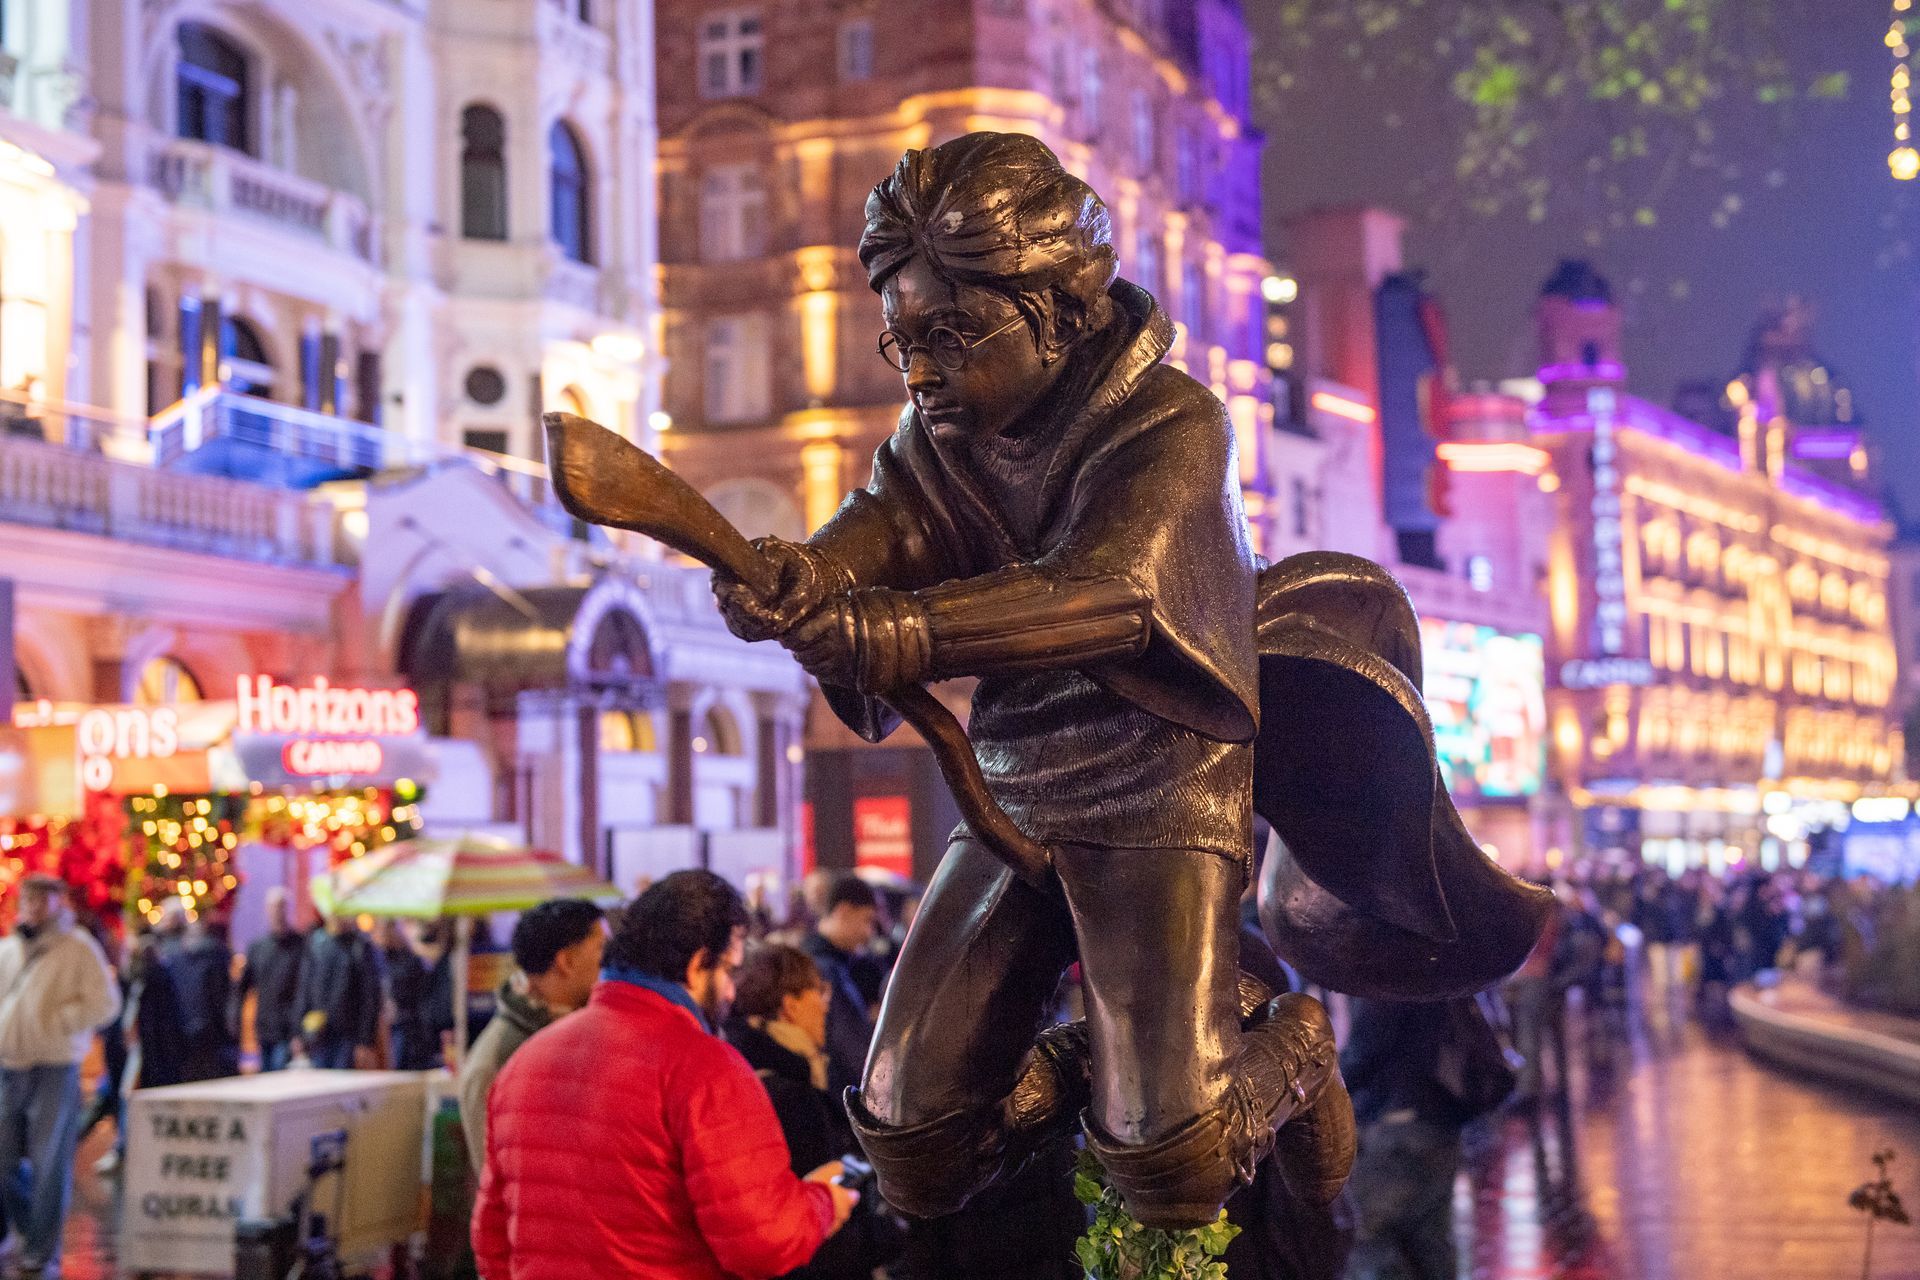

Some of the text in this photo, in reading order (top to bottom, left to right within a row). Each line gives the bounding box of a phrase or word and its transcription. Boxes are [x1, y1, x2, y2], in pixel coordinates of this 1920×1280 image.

[237, 674, 418, 735] Horizons
[151, 1114, 247, 1142] TAKE A
[161, 1153, 231, 1183] FREE
